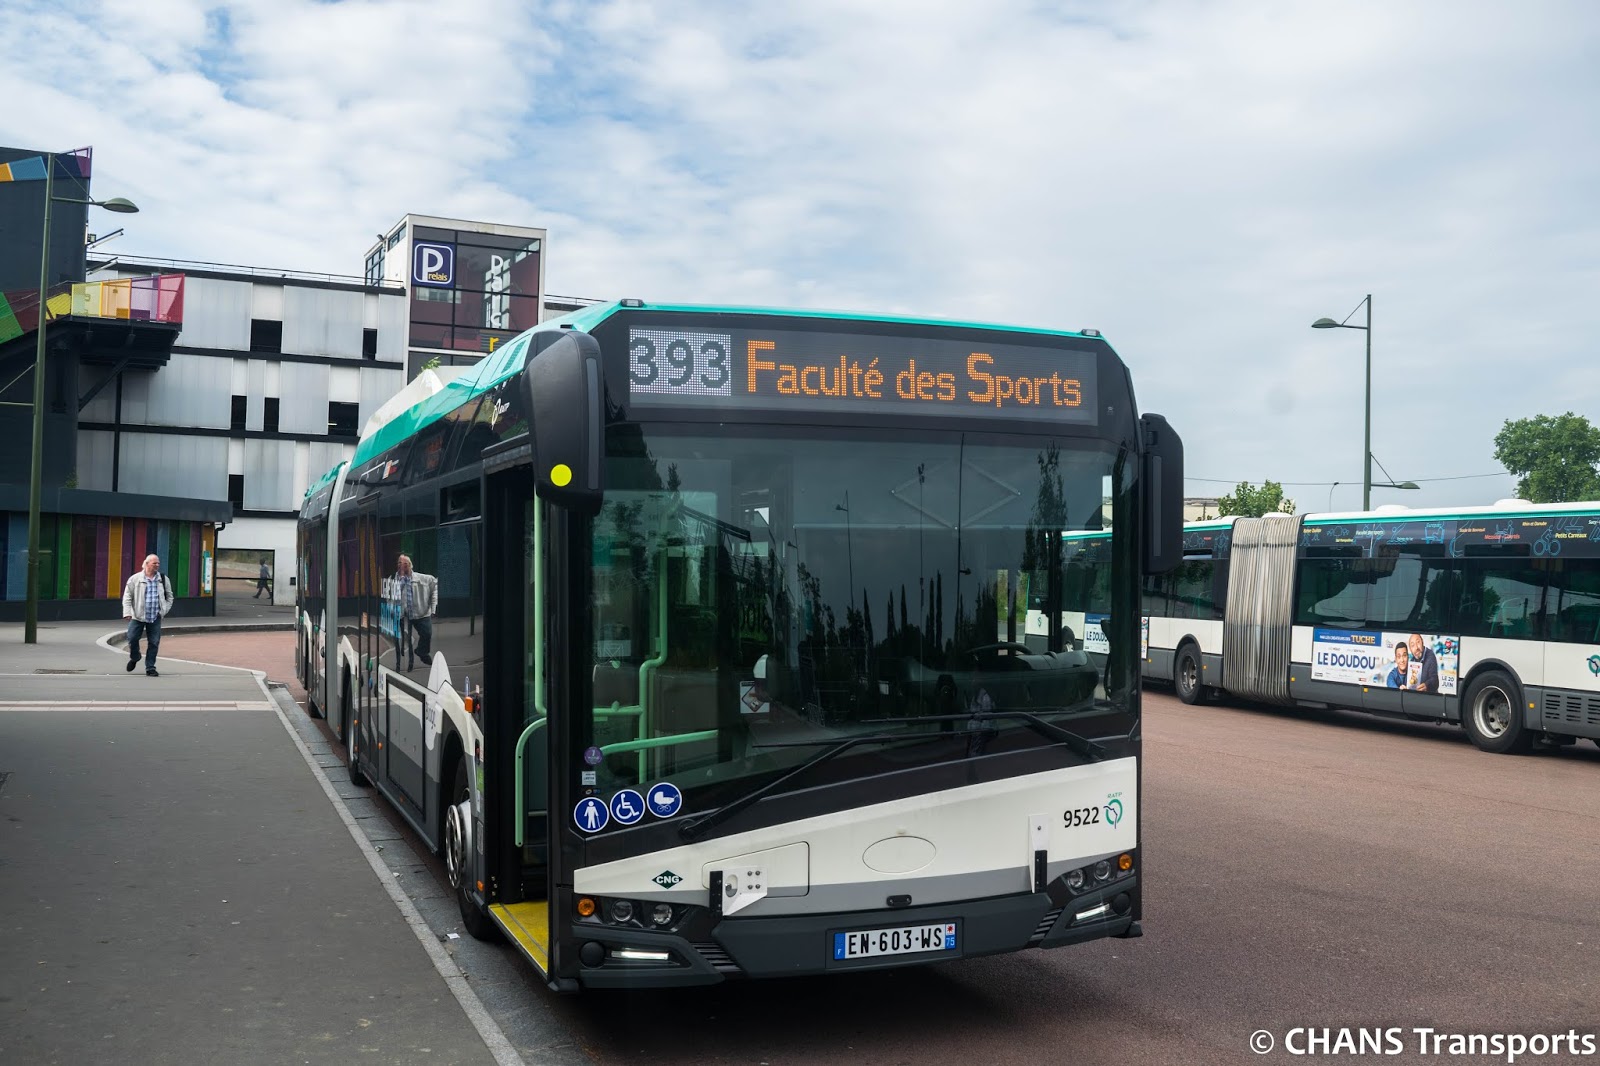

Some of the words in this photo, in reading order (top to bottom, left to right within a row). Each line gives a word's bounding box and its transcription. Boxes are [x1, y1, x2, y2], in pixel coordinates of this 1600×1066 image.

[422, 247, 444, 281] P
[428, 272, 448, 281] relais
[630, 336, 729, 389] 393
[747, 340, 884, 398] Faculté
[896, 359, 956, 401] des
[967, 352, 1081, 408] Sports
[1351, 634, 1376, 644] TUCHE
[1318, 652, 1328, 665] LE
[1330, 654, 1376, 670] DOUDOU
[1063, 806, 1100, 828] 9522
[656, 875, 680, 884] CNG
[946, 937, 955, 946] 75
